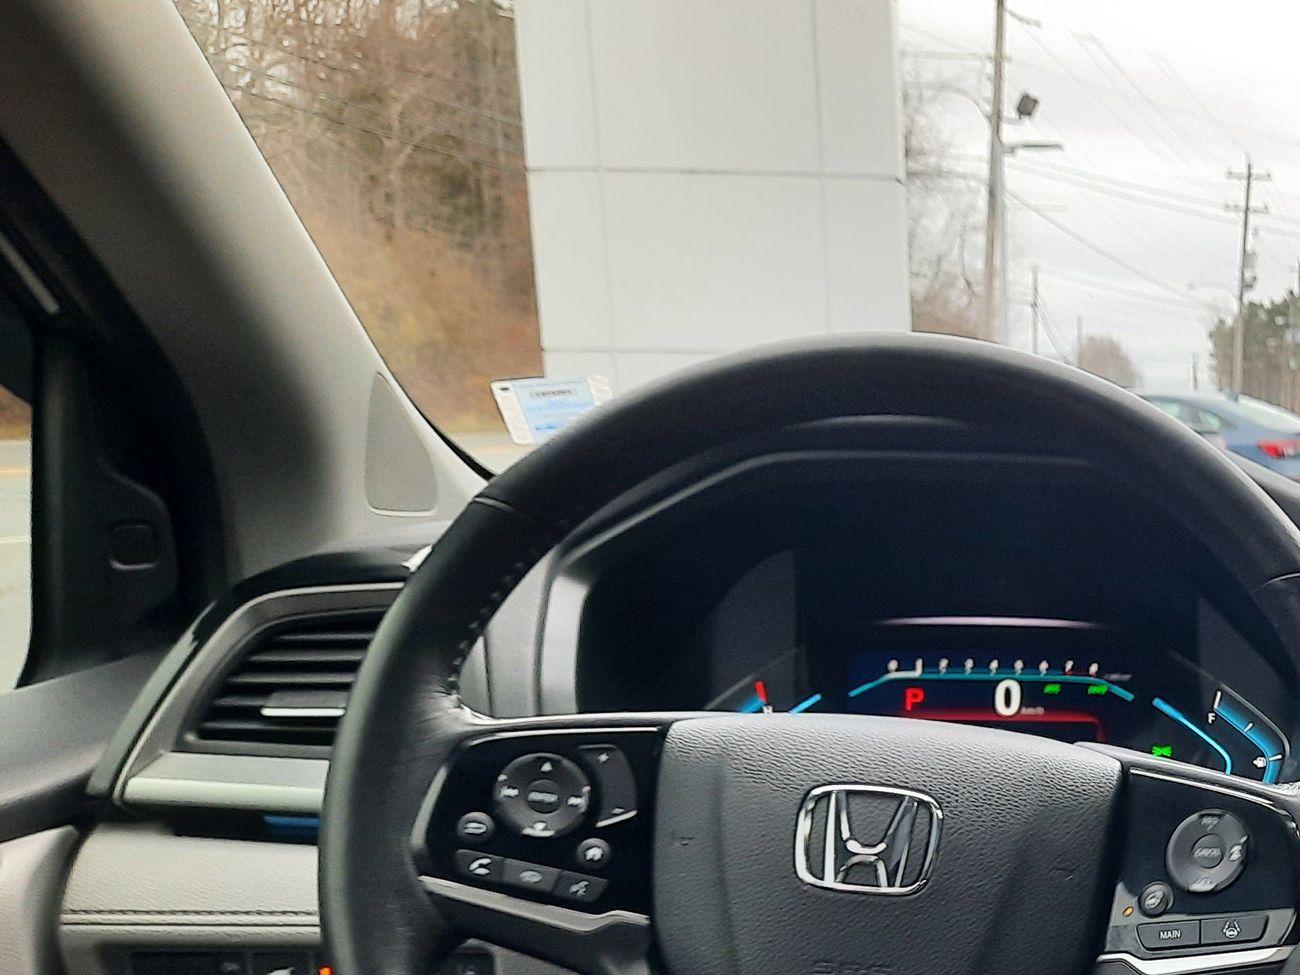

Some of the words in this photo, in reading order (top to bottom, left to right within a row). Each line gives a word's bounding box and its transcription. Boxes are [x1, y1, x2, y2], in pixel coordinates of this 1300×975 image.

[905, 687, 924, 712] P
[994, 678, 1021, 716] 0
[1208, 712, 1216, 724] F
[1159, 930, 1182, 940] MAIN
